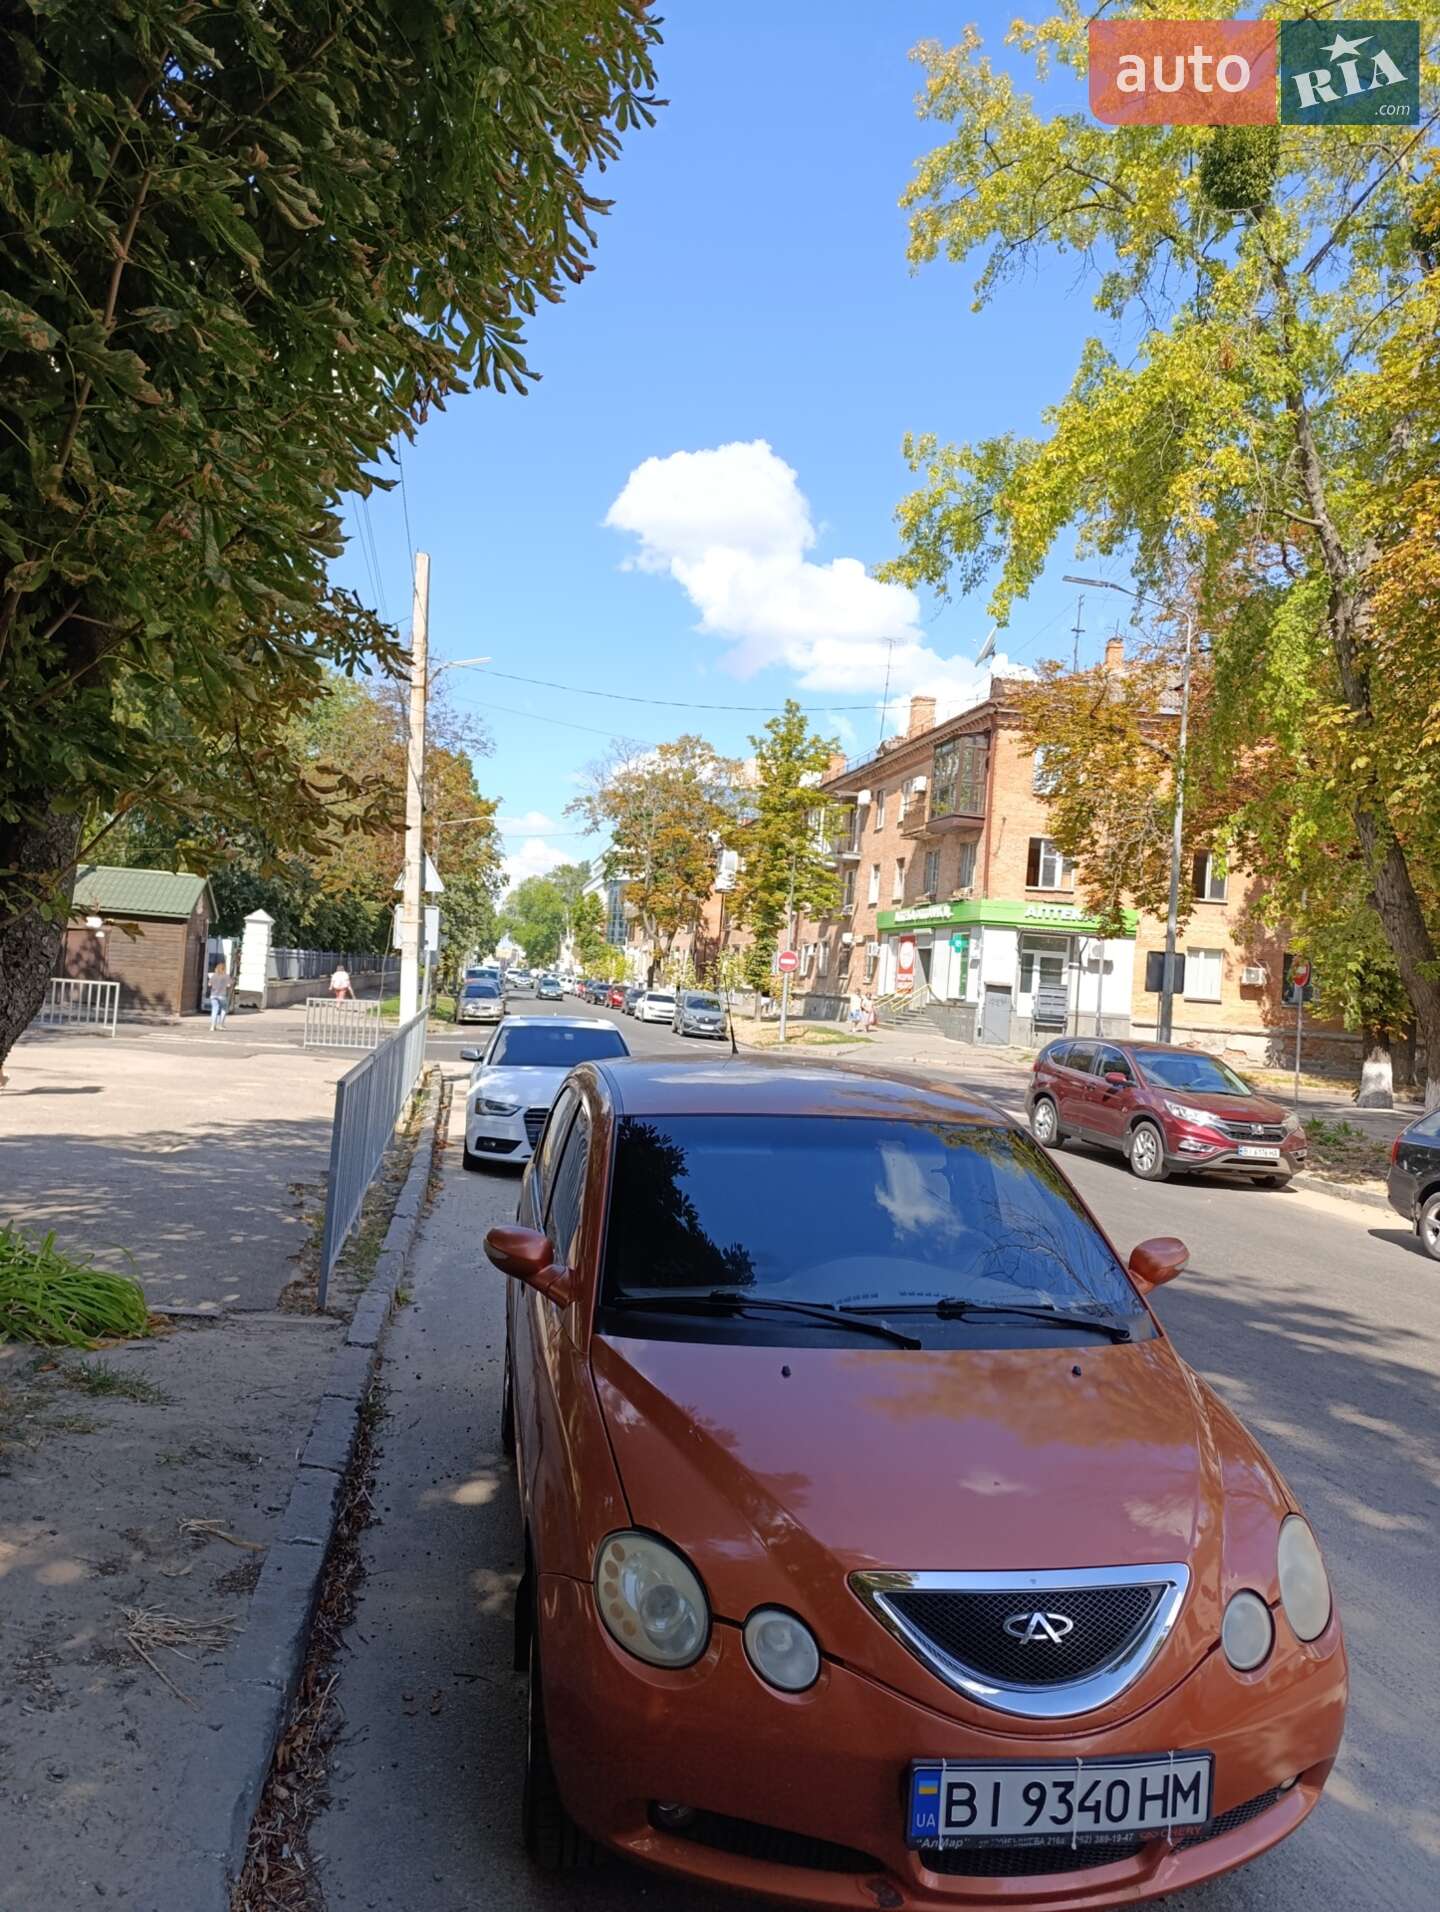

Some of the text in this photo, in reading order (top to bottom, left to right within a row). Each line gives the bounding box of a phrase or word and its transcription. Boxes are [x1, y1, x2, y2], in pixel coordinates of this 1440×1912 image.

[944, 1770, 1202, 1828] BI 9340 HM
[916, 1812, 936, 1828] UA
